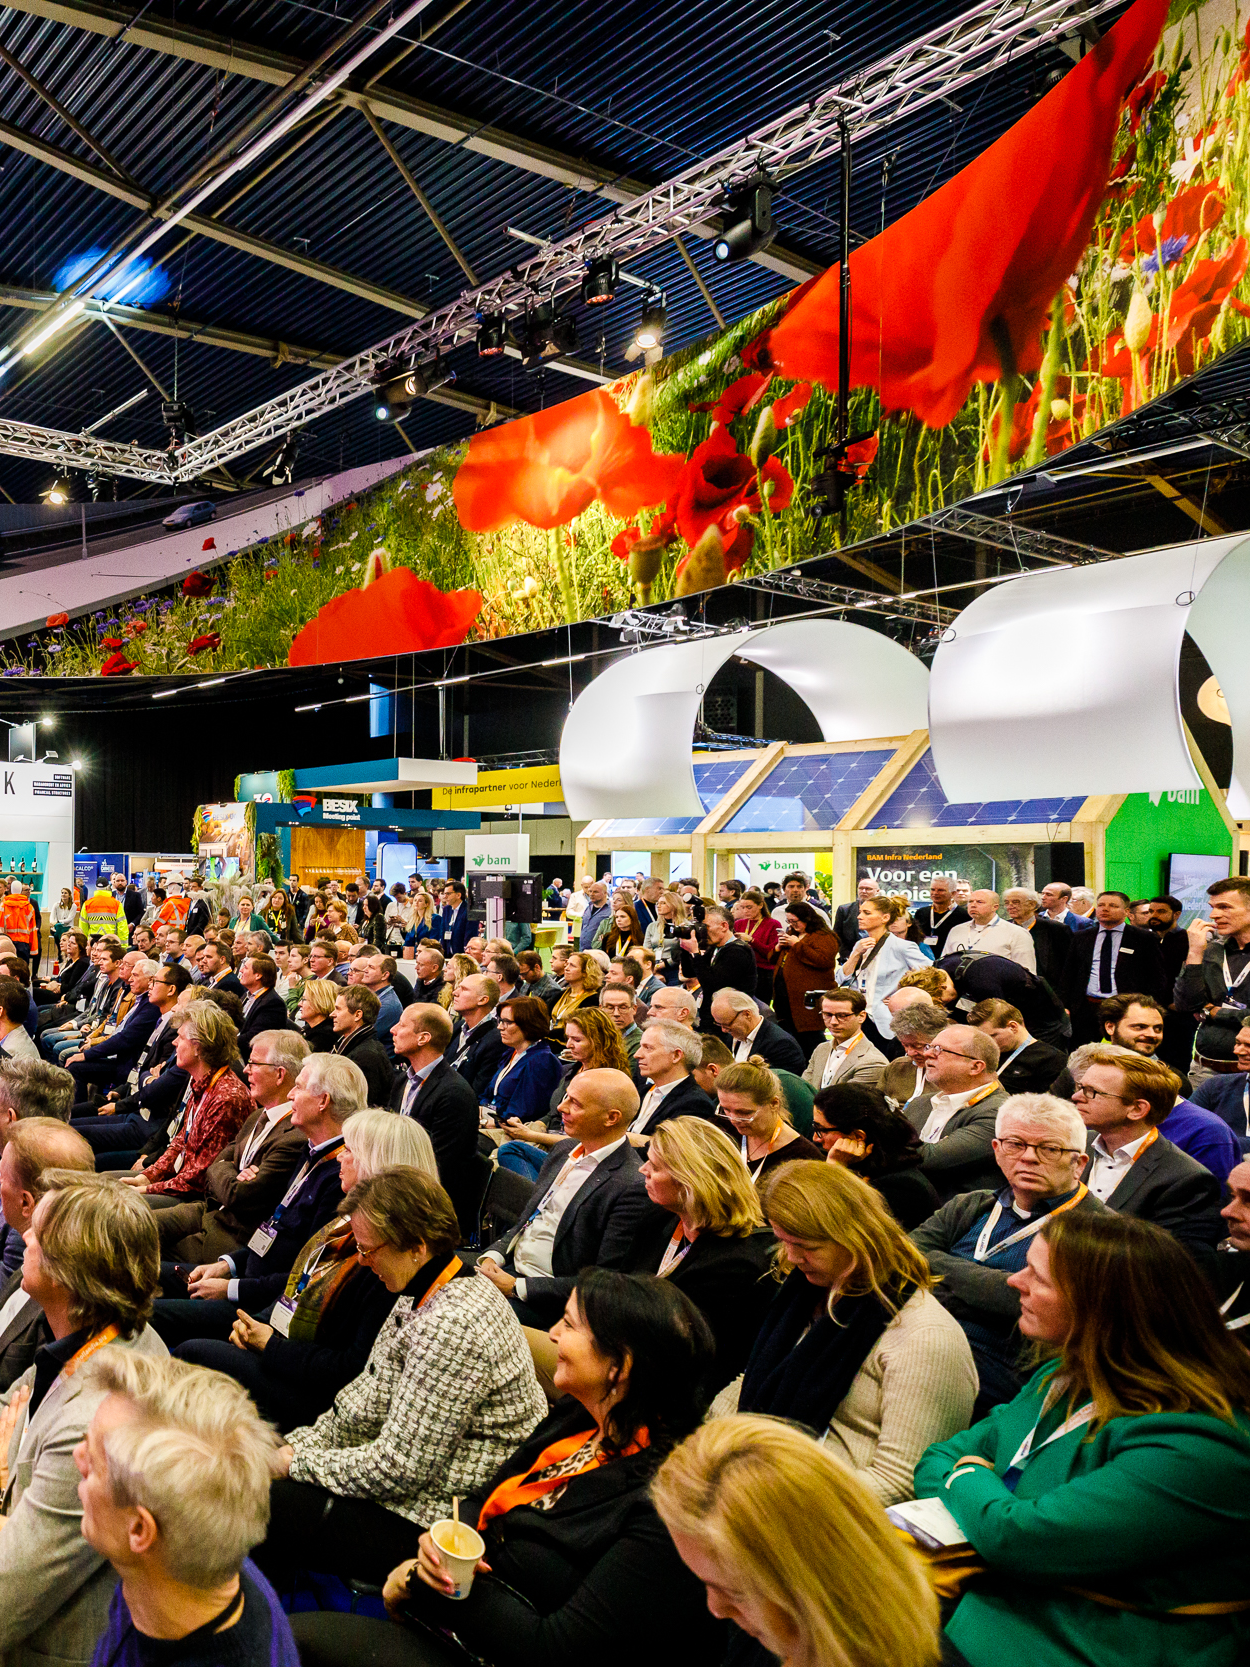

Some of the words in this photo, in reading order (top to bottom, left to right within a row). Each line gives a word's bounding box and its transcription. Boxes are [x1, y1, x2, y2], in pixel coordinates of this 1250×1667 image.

[442, 787, 453, 796] De
[454, 784, 507, 796] infrapartner
[508, 782, 529, 790] voor
[530, 778, 562, 789] Nederl
[322, 798, 359, 813] BESIX
[322, 812, 345, 821] Meeting
[345, 813, 361, 822] point
[487, 854, 511, 865] bam
[902, 853, 943, 861] Nederland
[774, 860, 799, 870] bam
[866, 867, 916, 883] Voor
